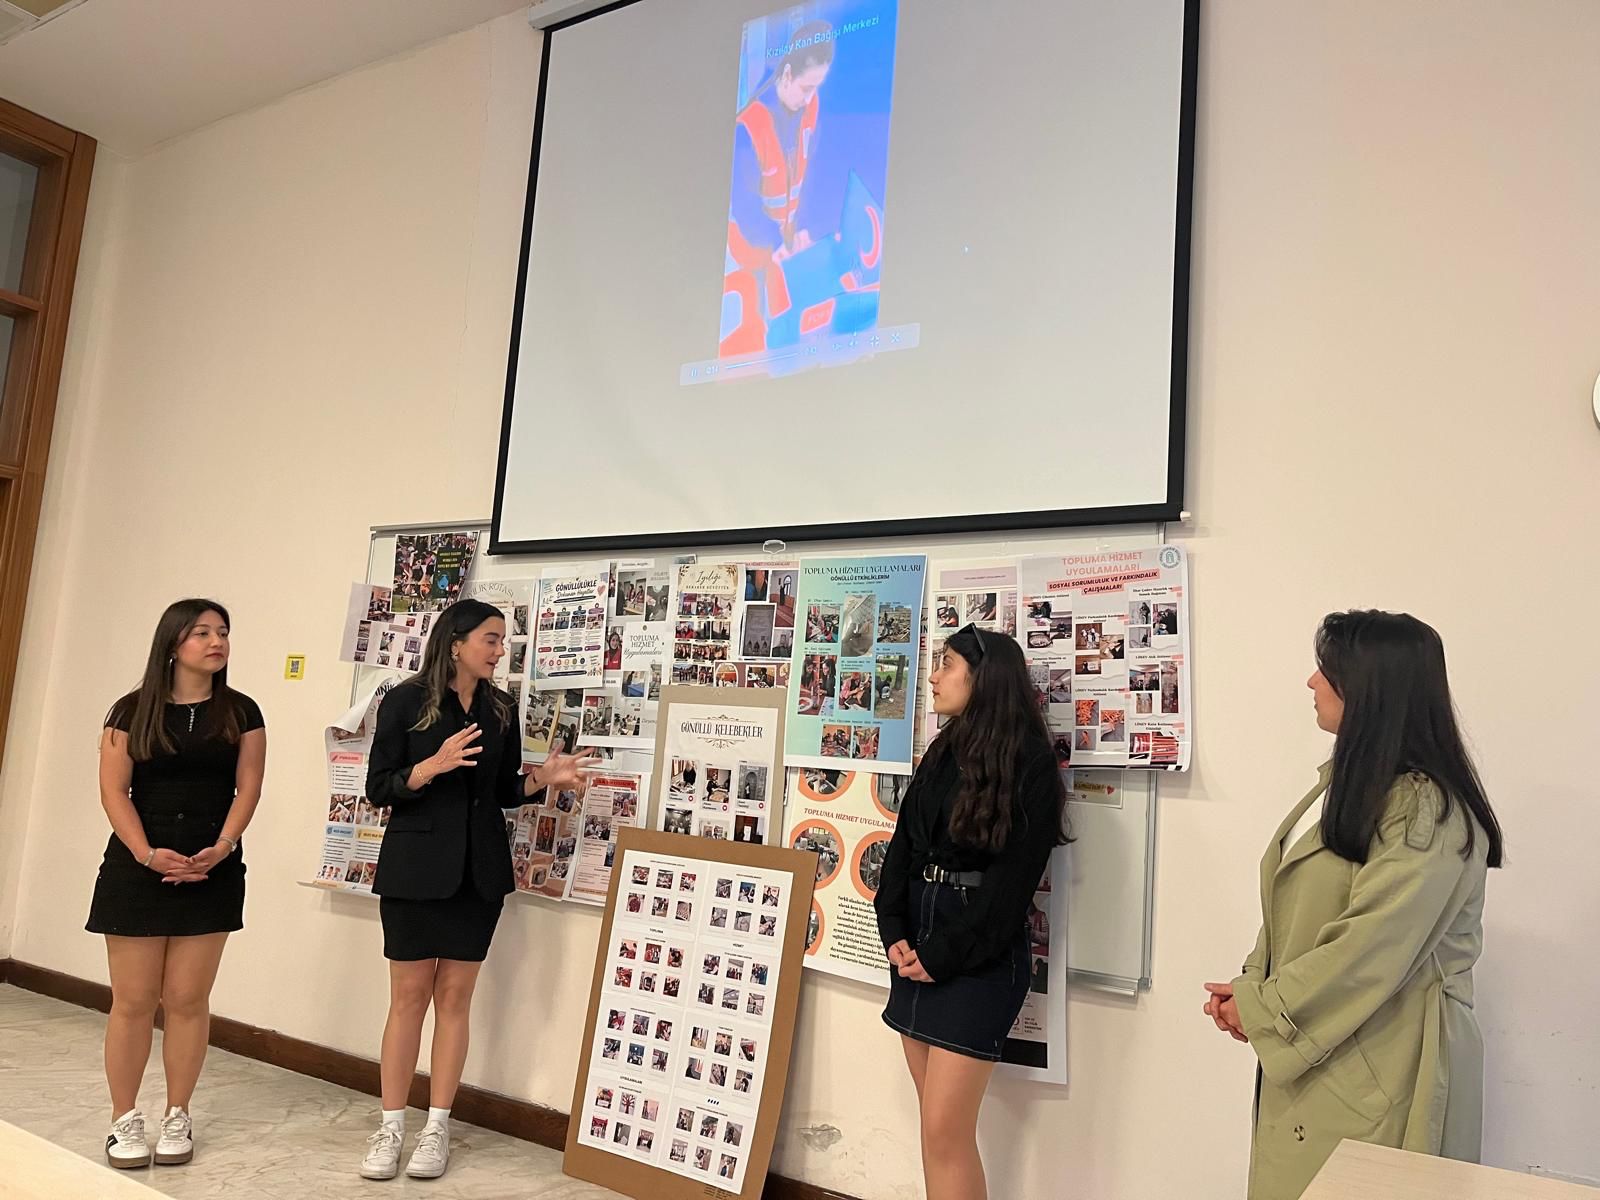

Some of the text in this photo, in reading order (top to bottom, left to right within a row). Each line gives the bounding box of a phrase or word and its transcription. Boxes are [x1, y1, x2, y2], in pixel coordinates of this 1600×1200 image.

[795, 36, 812, 49] Kan
[842, 16, 880, 34] Merkezi
[1062, 552, 1143, 566] TOPLUMA HİZMET
[866, 565, 920, 573] UYGULAMALARI
[1066, 564, 1140, 576] UYGULAMALARI
[1072, 578, 1110, 587] SORUMLULUK
[1118, 572, 1158, 581] FARKINDALIK
[556, 580, 597, 592] GÖNÜLLÜLÜKLE
[1083, 584, 1122, 594] ÇALIŞMALARI
[680, 722, 763, 738] GÖNÜLLÜ KELEBEKLER
[804, 808, 835, 818] TOPLUMA
